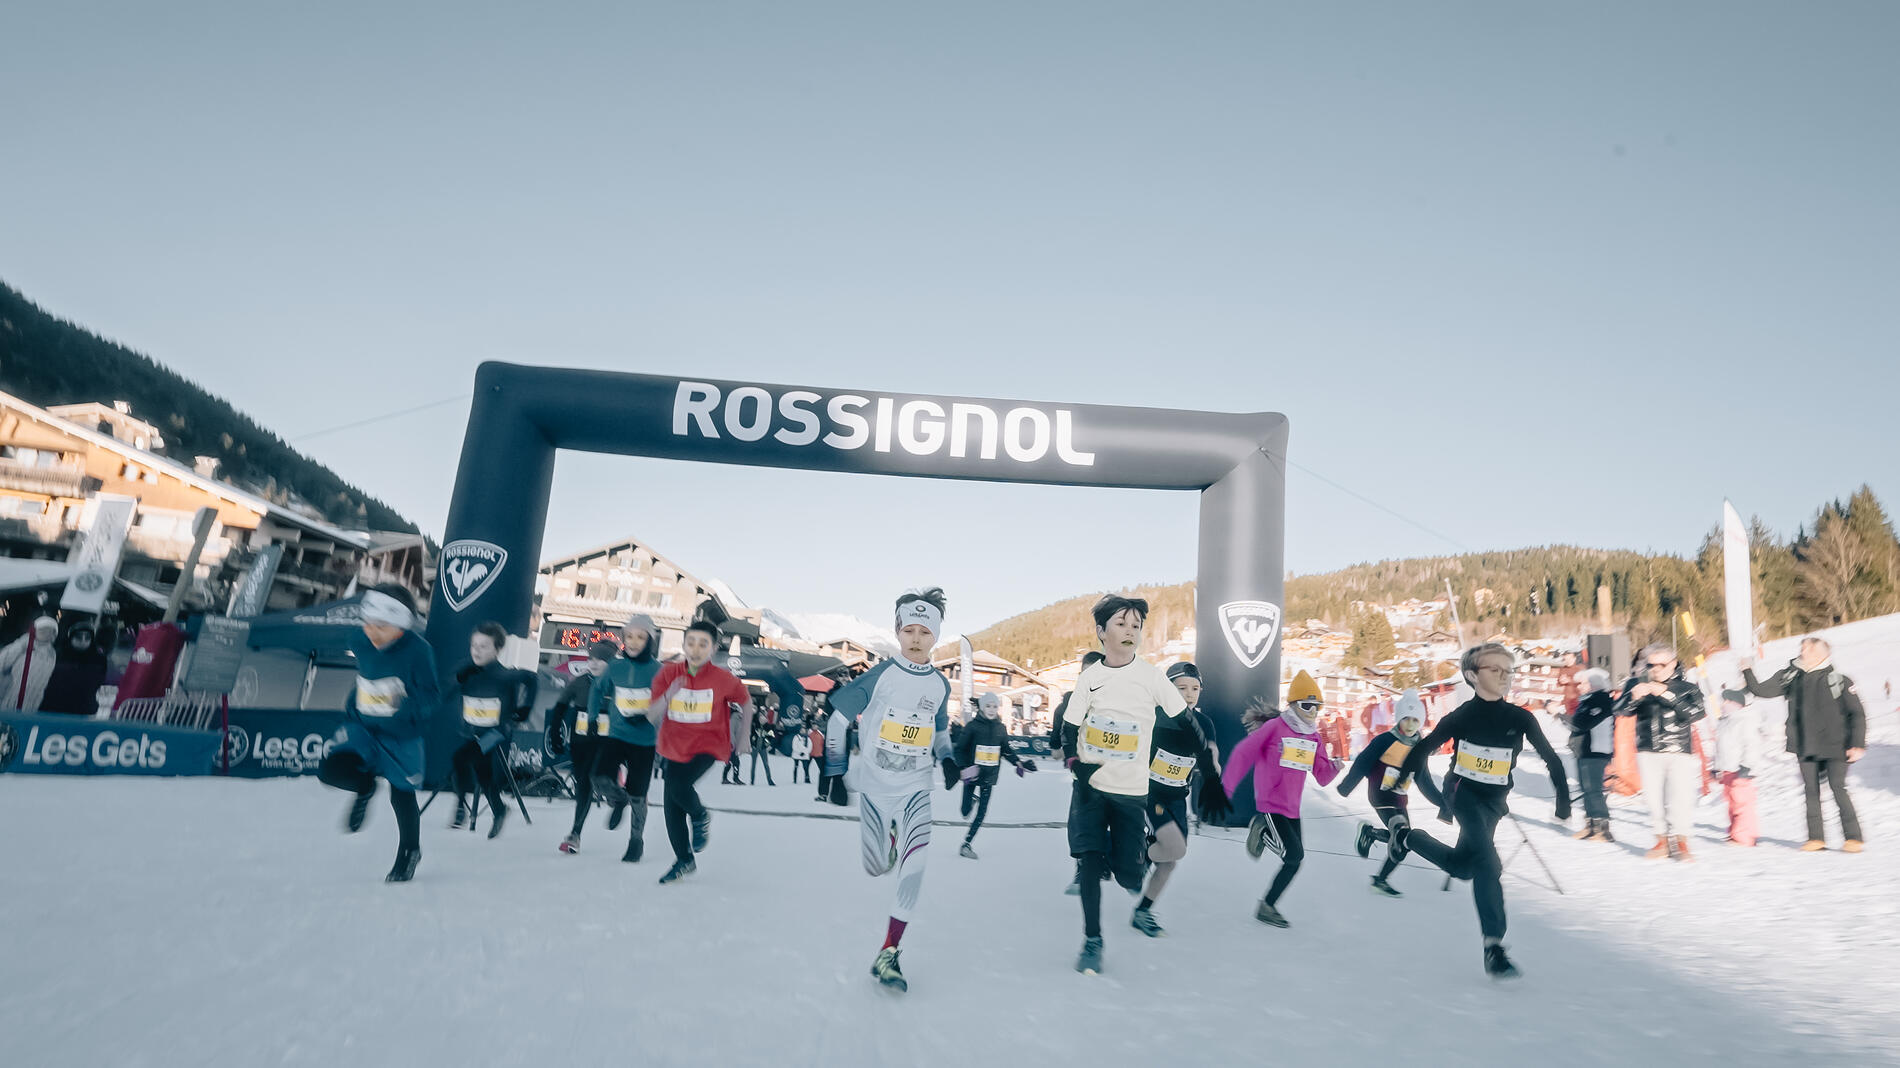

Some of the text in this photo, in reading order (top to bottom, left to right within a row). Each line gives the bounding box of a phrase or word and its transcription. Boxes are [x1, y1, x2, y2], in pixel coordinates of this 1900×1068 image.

[672, 380, 1096, 466] ROSSIGNOL
[445, 544, 497, 563] ROSSIGNOL
[901, 725, 920, 740] 507
[1101, 731, 1121, 745] 538
[23, 725, 167, 768] Les Gets
[252, 732, 299, 760] Les
[1166, 764, 1182, 776] 559
[1475, 757, 1494, 771] 534
